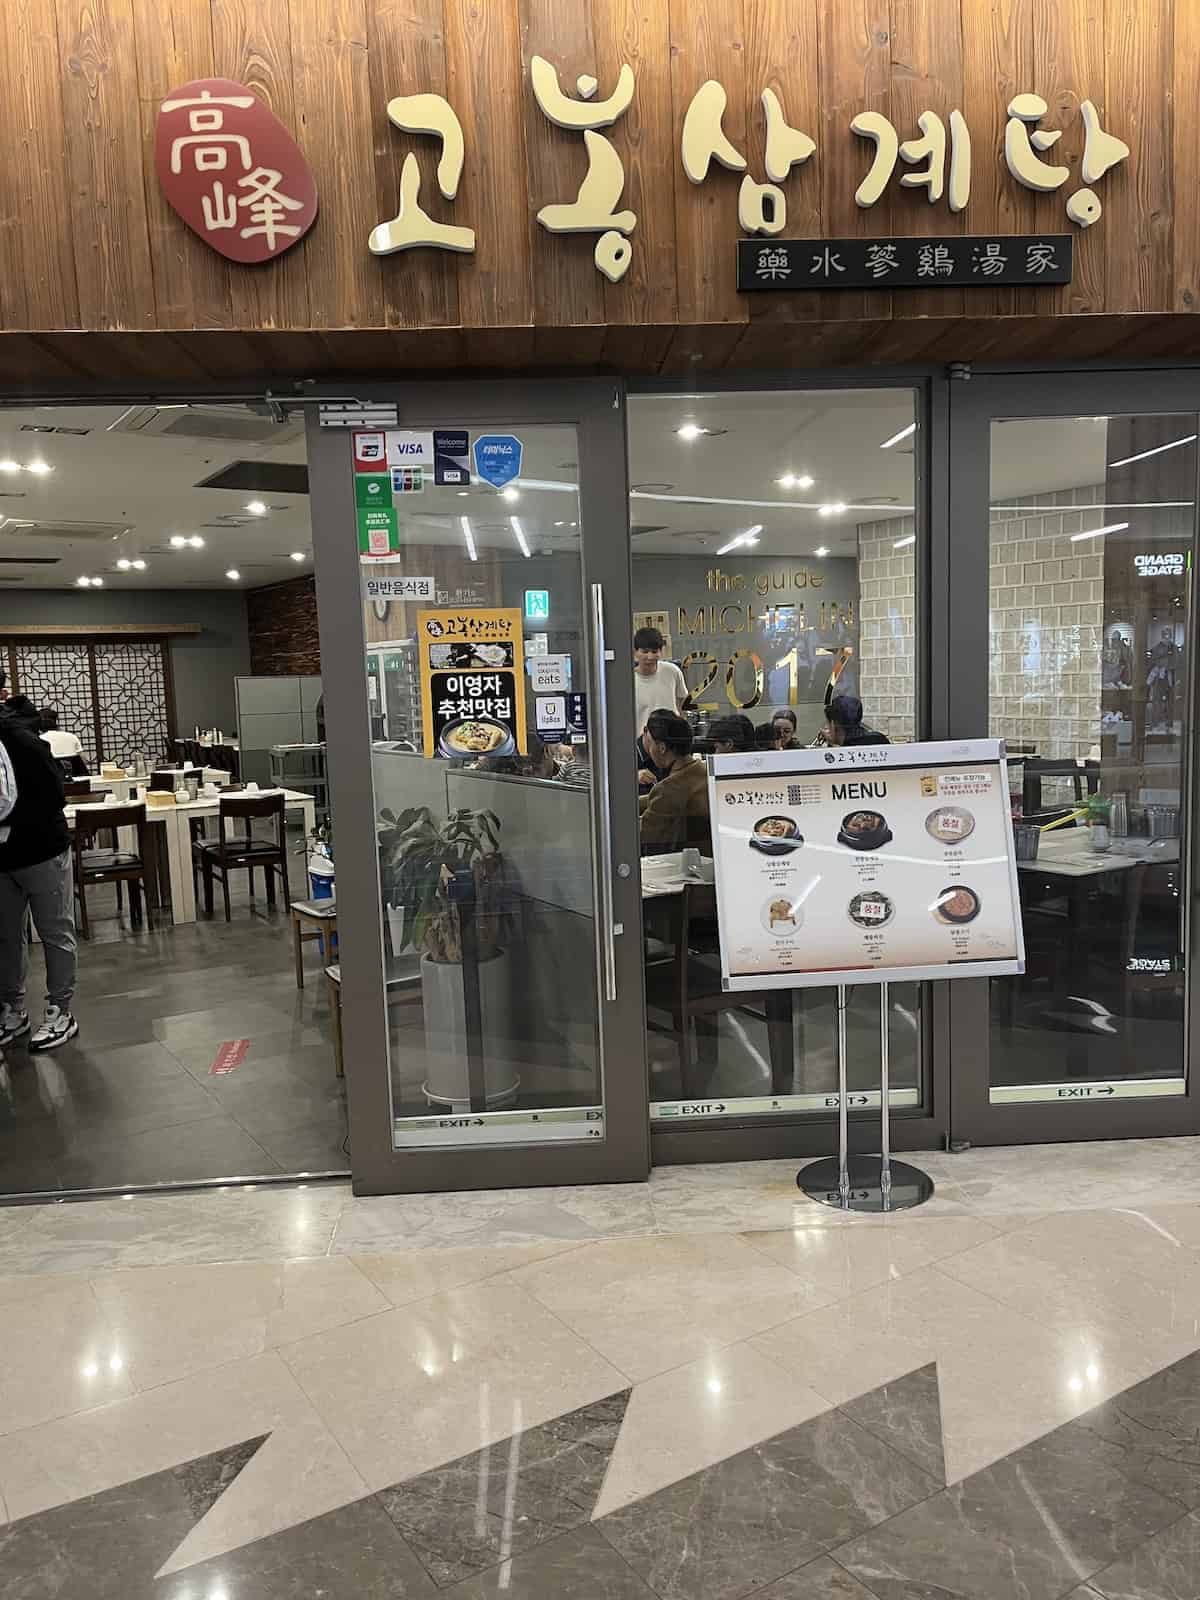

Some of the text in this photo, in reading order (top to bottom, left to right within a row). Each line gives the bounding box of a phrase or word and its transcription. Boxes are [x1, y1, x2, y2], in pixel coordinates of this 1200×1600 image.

[161, 90, 304, 251] 高峰
[368, 55, 1130, 283] 고봉삼계탕
[397, 443, 423, 455] VISA
[367, 580, 429, 596] 일반음식점
[705, 568, 824, 596] the guide
[677, 601, 854, 635] MICHELIN
[446, 674, 503, 697] 이영자
[538, 674, 561, 685] eats
[681, 647, 853, 711] 2017
[437, 696, 511, 721] 추천맛집
[831, 781, 888, 801] MENU
[1057, 1087, 1094, 1097] EXIT
[681, 1104, 713, 1115] EXIT
[439, 1119, 472, 1129] EXIT
